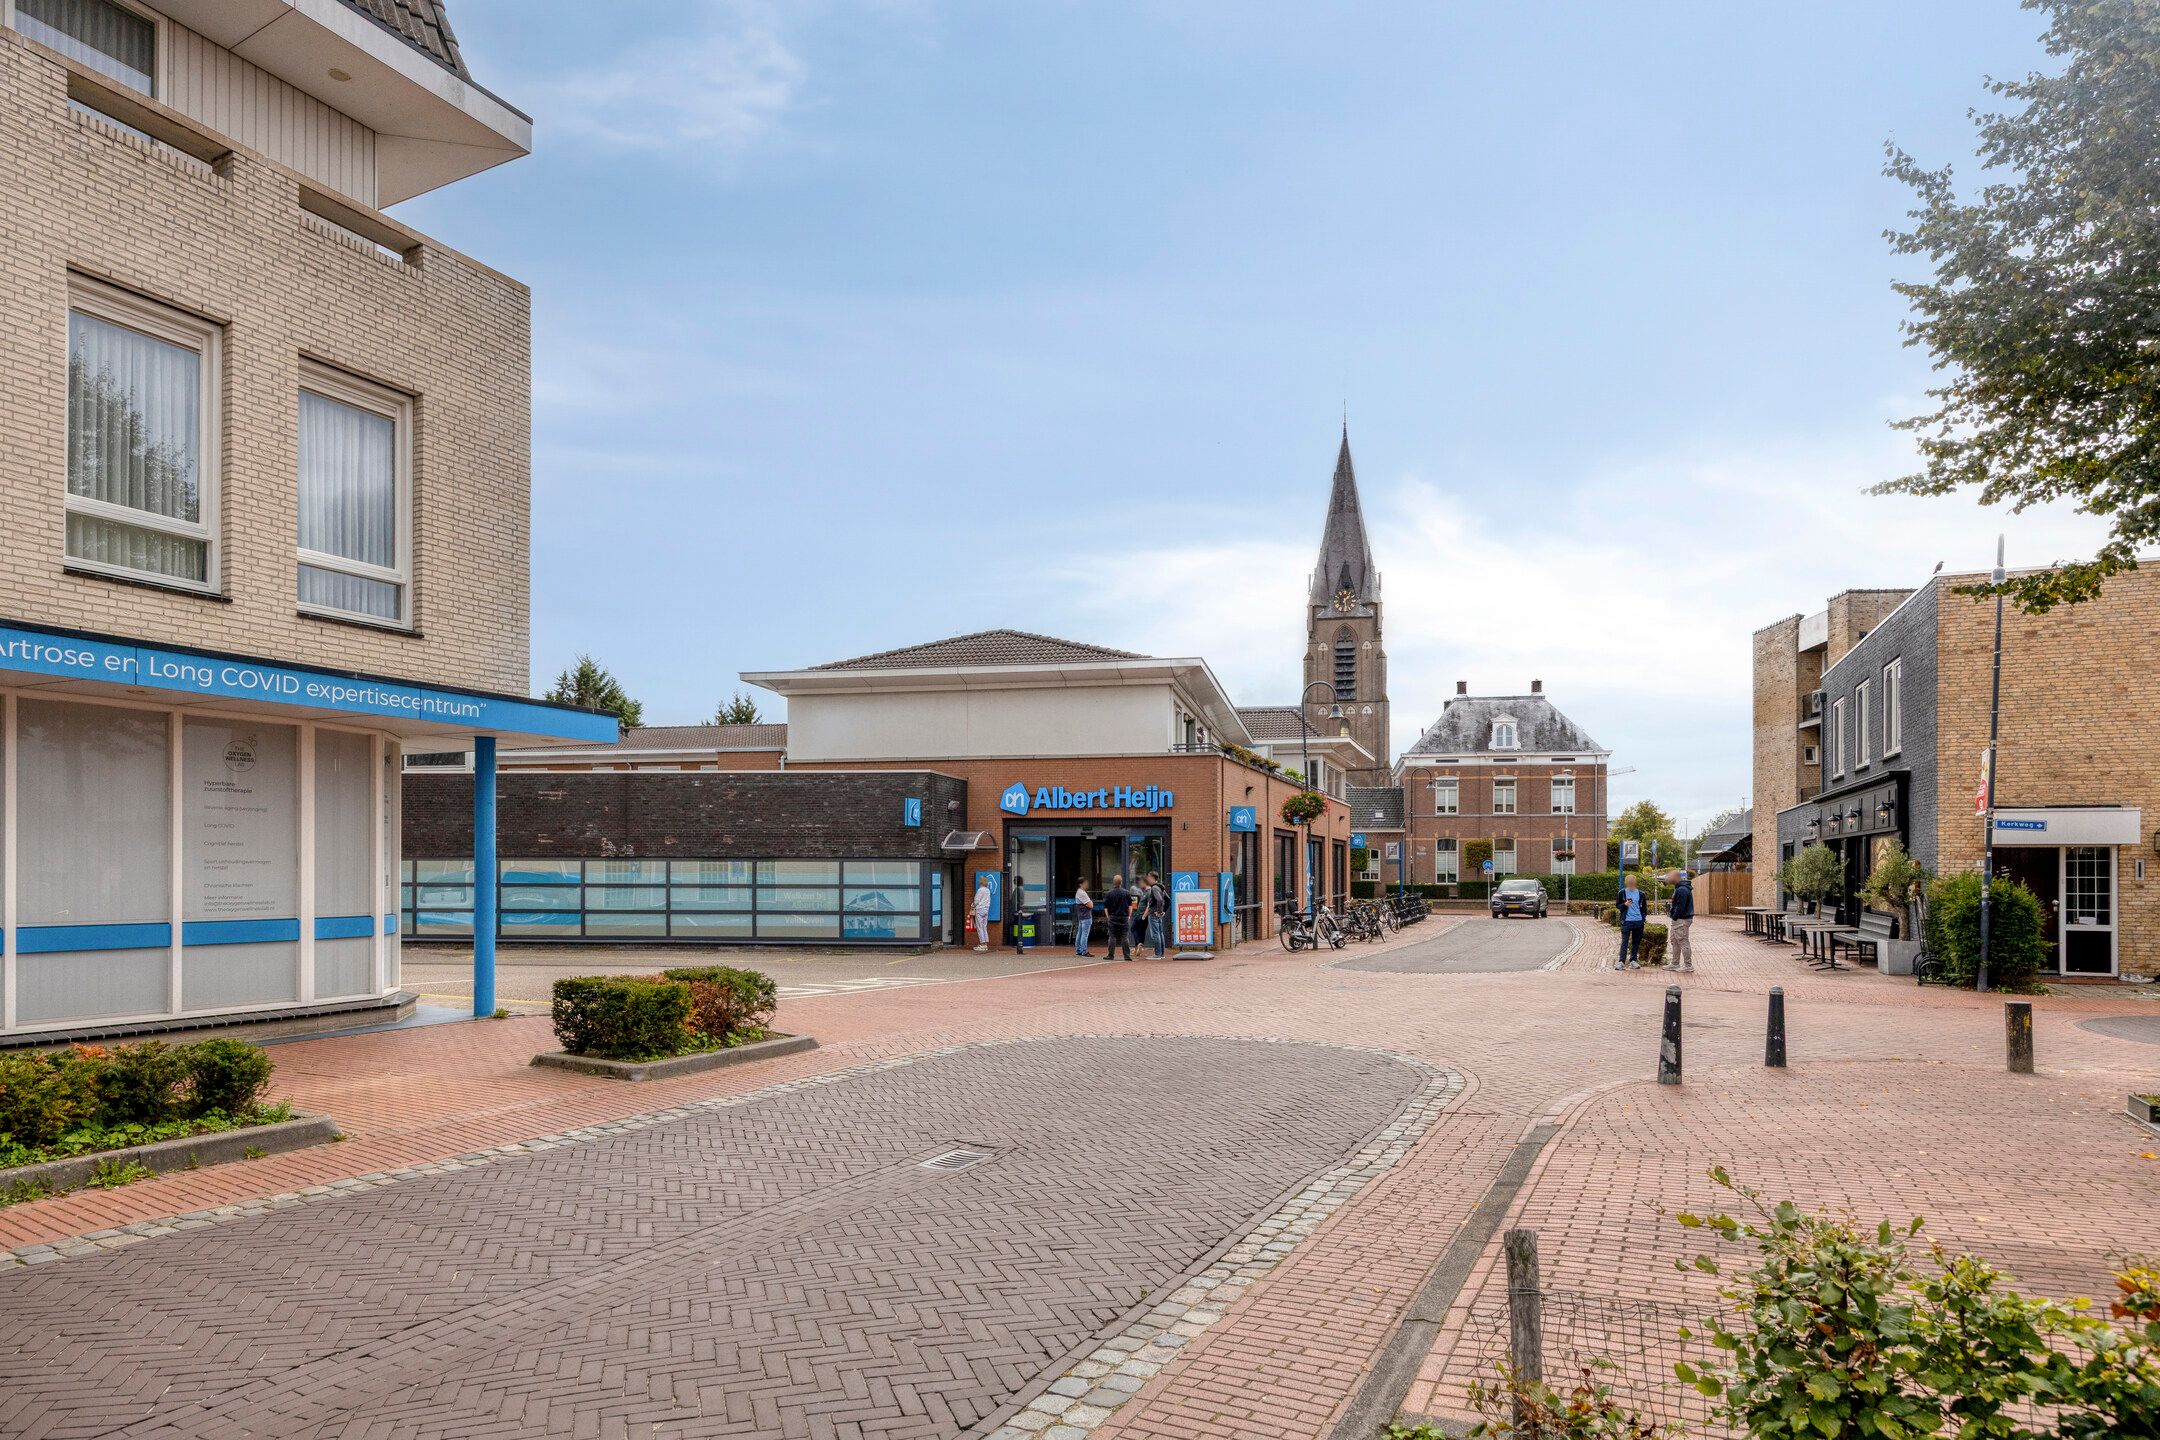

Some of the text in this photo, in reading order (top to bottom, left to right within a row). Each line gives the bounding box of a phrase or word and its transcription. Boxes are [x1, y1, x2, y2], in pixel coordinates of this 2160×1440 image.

[104, 655, 139, 674] en
[150, 656, 213, 688] Long
[221, 667, 300, 694] COVID
[1032, 786, 1109, 809] Albert
[1113, 785, 1173, 814] Heijn
[2001, 821, 2034, 829] Kerkweg
